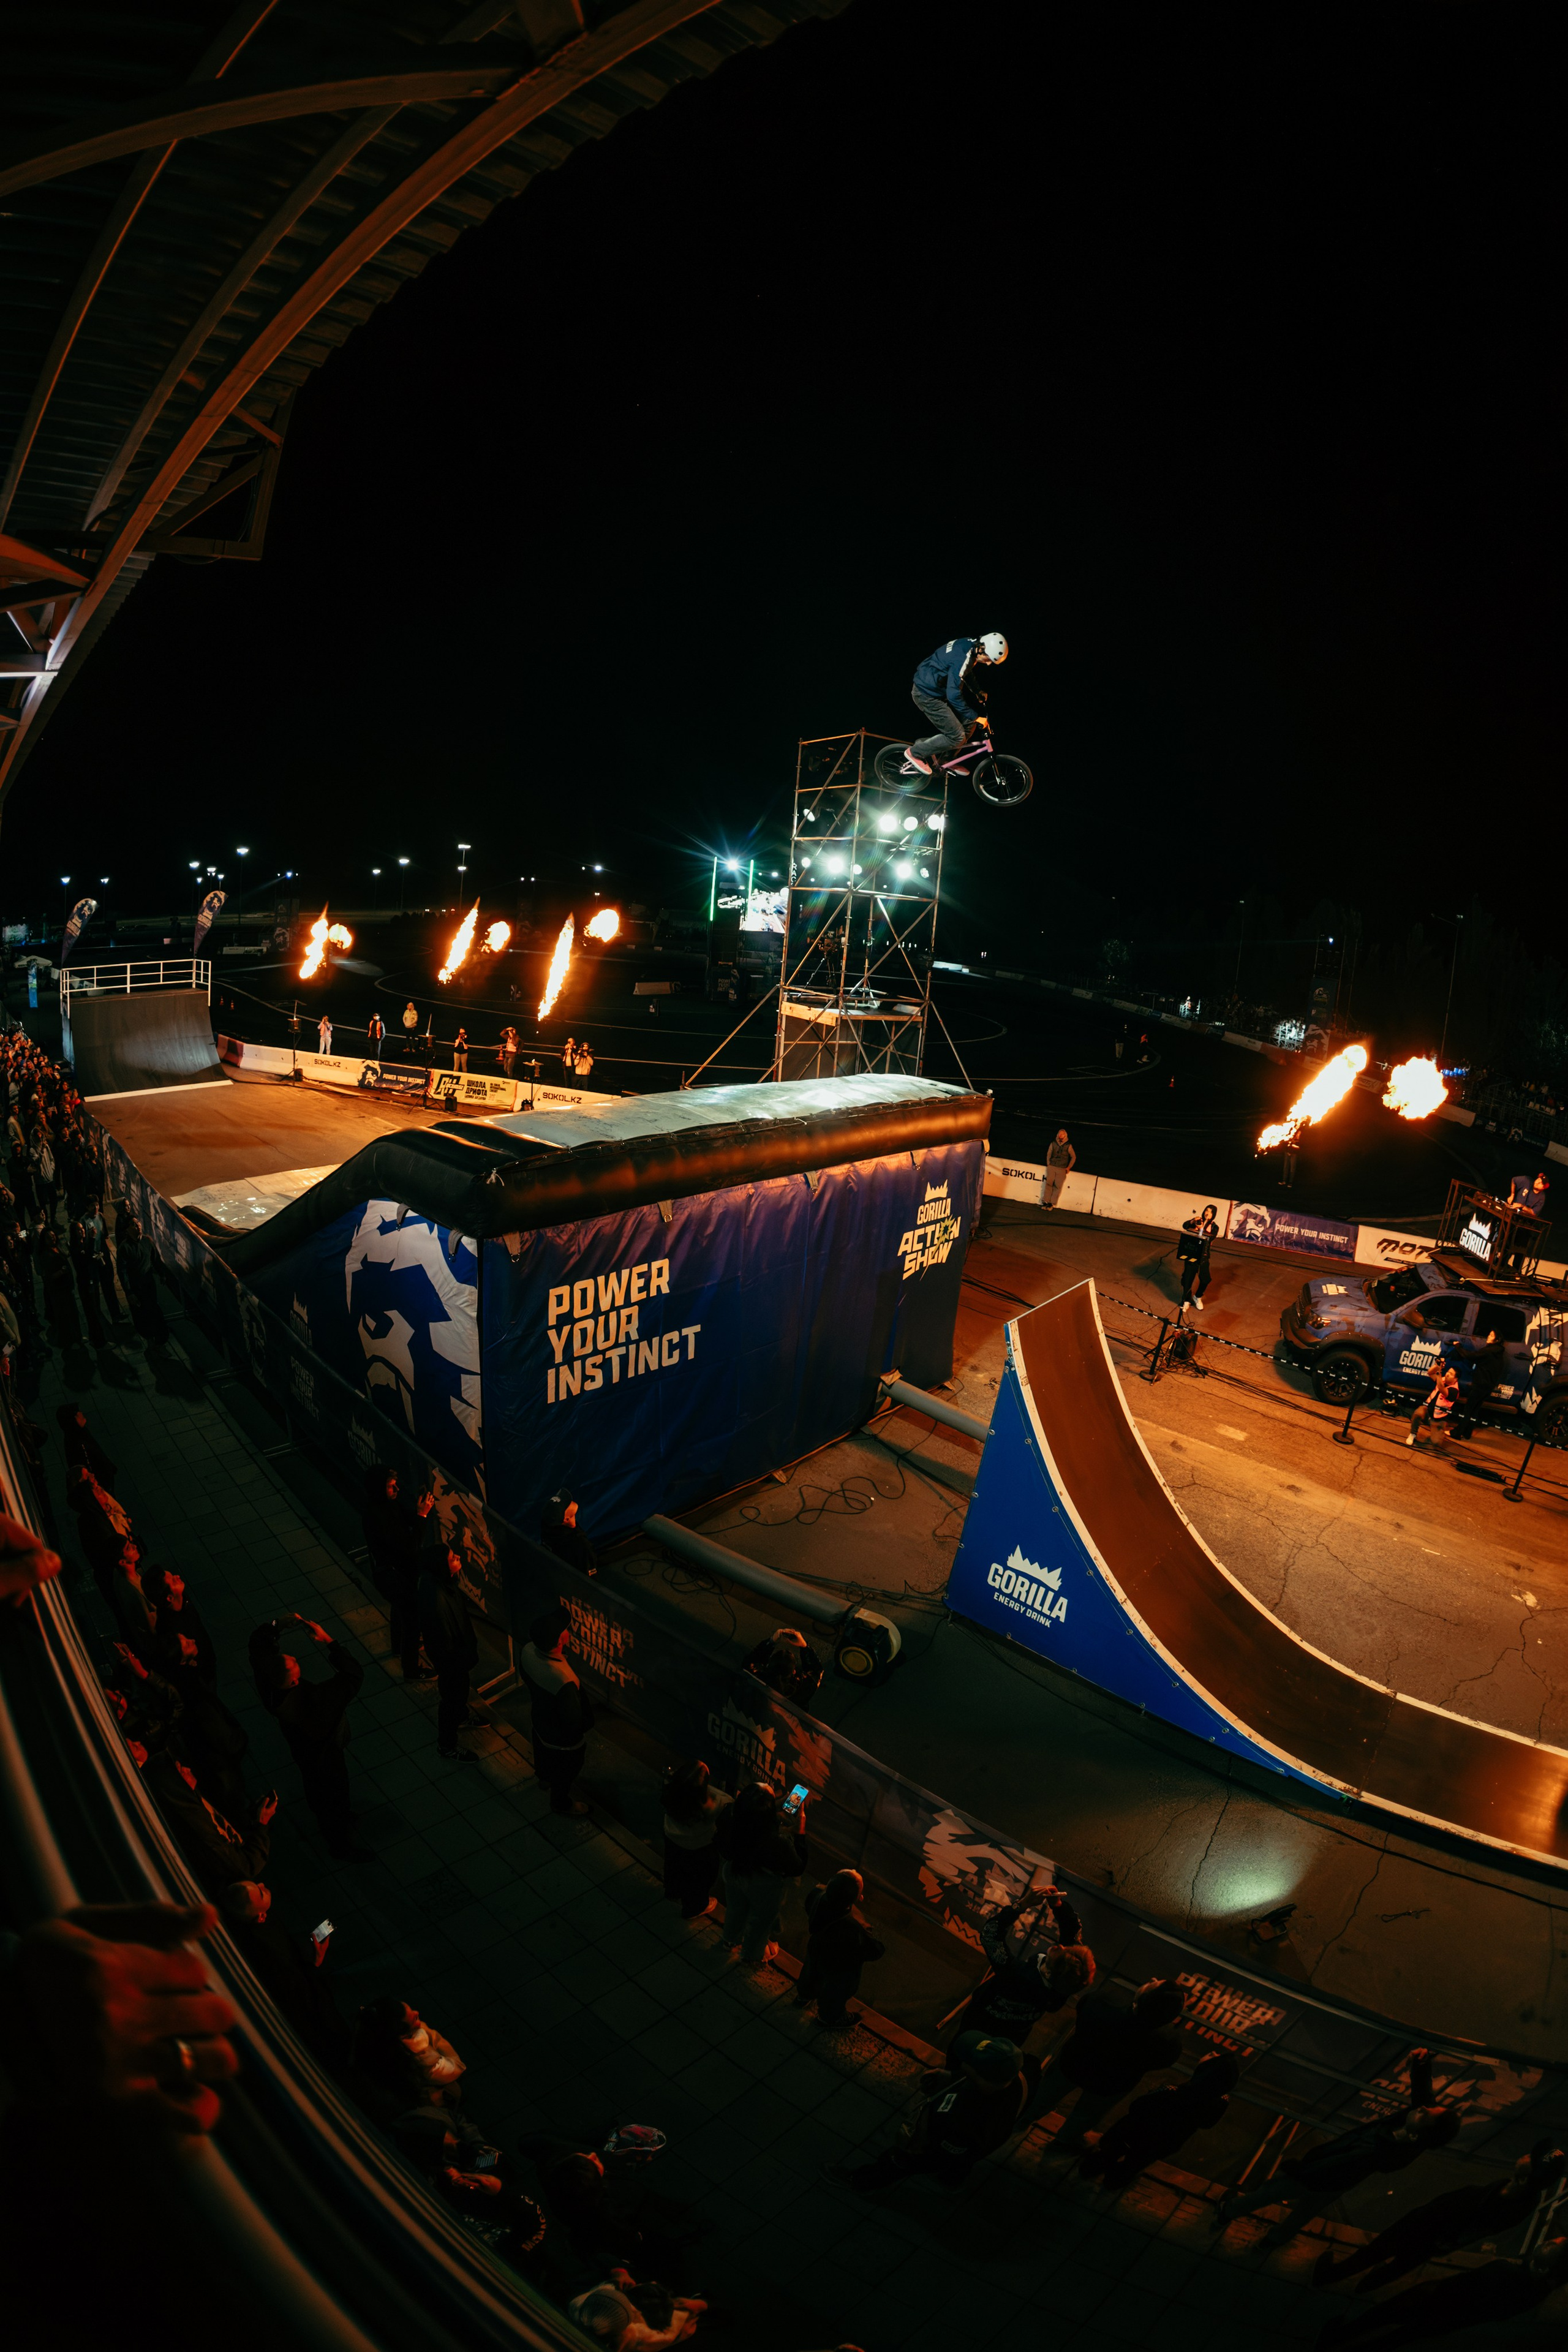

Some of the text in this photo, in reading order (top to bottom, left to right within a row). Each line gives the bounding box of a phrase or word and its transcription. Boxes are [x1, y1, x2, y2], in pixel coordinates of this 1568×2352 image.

[465, 1087, 488, 1097] ДРИФТА
[467, 1080, 486, 1089] ШКОЛА
[916, 1198, 951, 1225] GORILLA
[897, 1215, 961, 1257] ACTION
[1275, 1224, 1348, 1244] POWER YOUR INSTINCT
[1459, 1227, 1492, 1262] GORILLA
[902, 1240, 953, 1281] SHOW
[548, 1258, 670, 1327] POWER
[547, 1305, 639, 1364] YOUR
[547, 1324, 701, 1404] INSTINCT
[1399, 1350, 1437, 1370] GORIL
[987, 1562, 1068, 1623] GORILLA
[993, 1591, 1052, 1628] ENERGY DRINK
[707, 1711, 786, 1788] GORILLA
